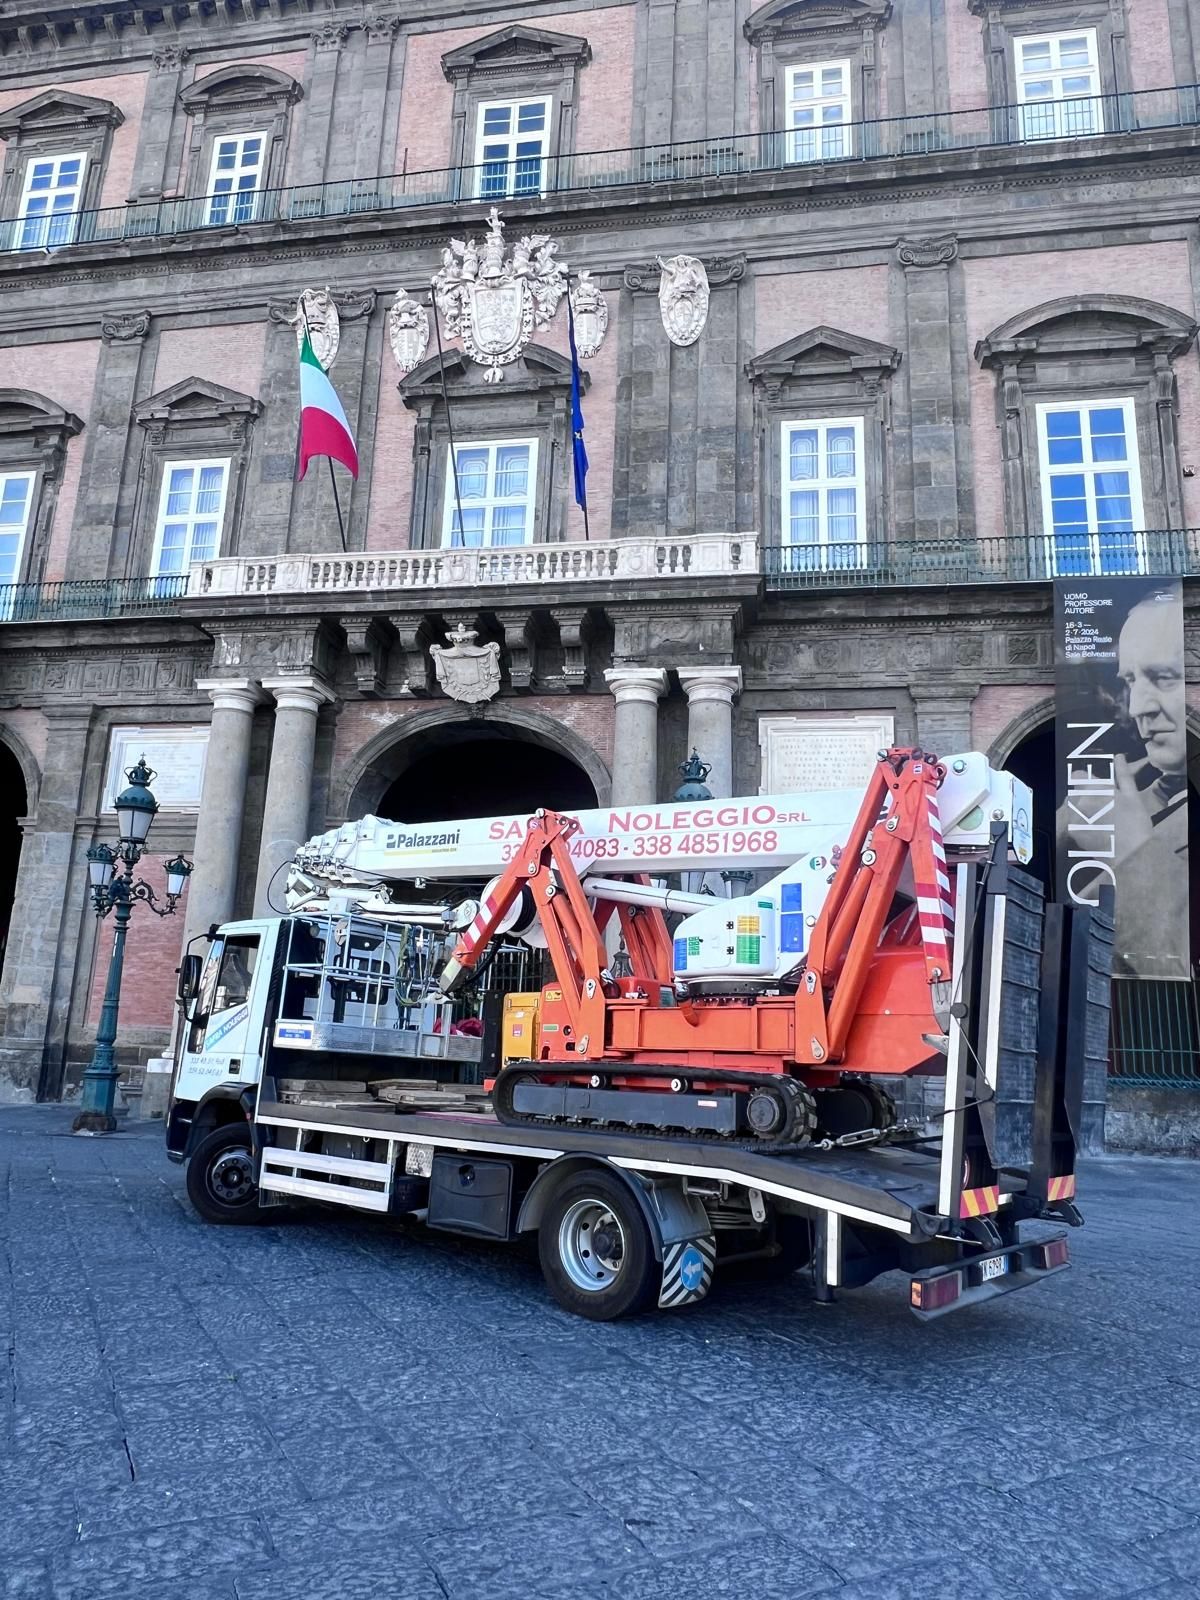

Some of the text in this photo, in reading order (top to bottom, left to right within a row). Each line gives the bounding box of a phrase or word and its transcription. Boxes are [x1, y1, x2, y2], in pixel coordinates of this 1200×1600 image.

[1064, 599, 1113, 607] PROFESSORE
[608, 805, 776, 833] NOLEGGIO
[777, 812, 811, 823] SRL
[1066, 723, 1116, 907] OLKIEN
[397, 828, 461, 849] Palazzani
[632, 835, 672, 857] 338
[677, 830, 778, 855] 4851968
